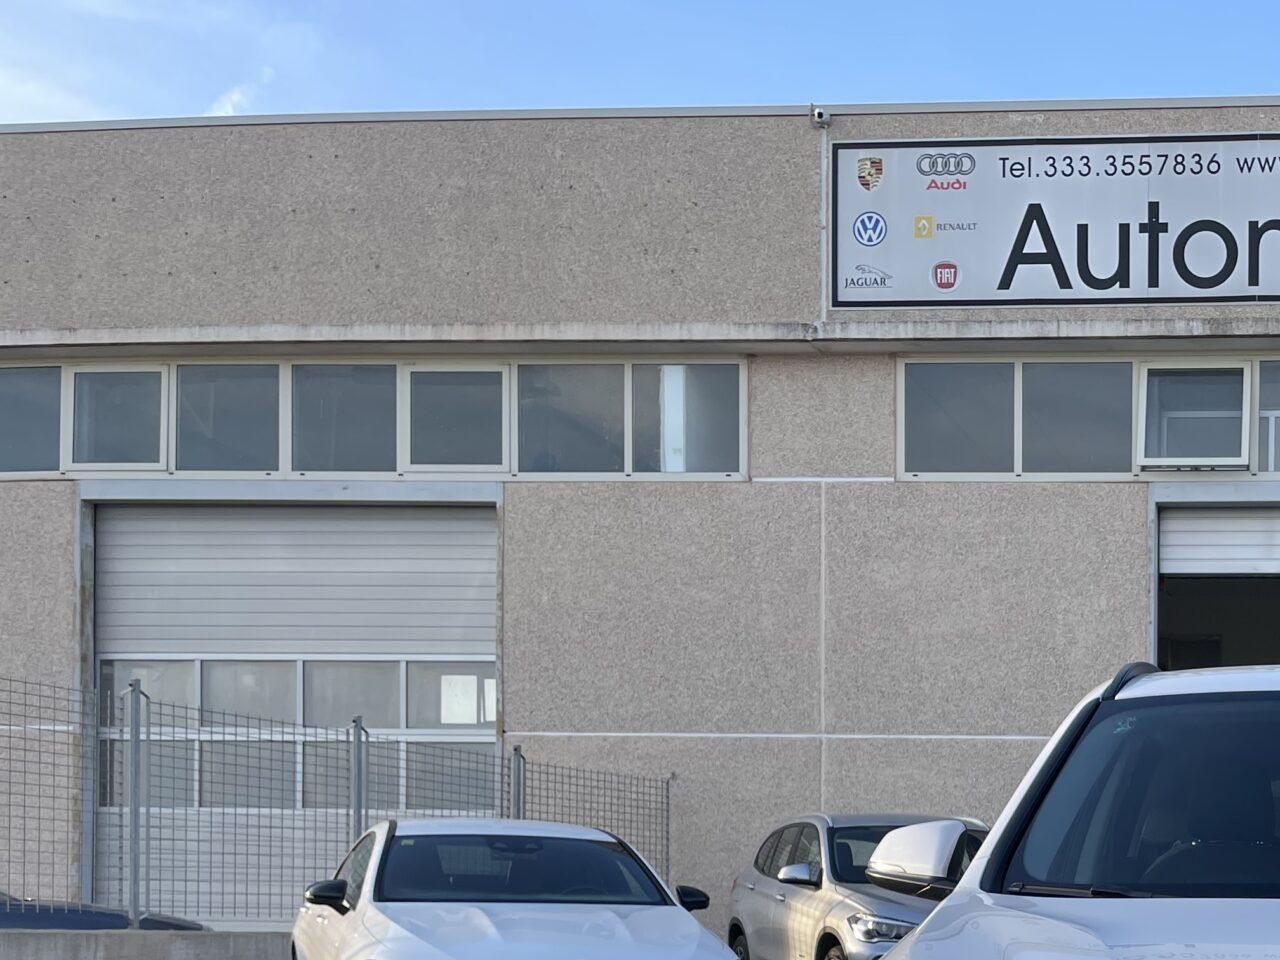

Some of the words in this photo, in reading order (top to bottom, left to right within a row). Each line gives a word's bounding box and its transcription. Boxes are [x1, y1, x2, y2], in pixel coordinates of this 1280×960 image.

[926, 179, 967, 190] Audi
[936, 222, 978, 232] RENAULT
[936, 268, 956, 284] FIAT
[844, 277, 887, 289] JAGUAR
